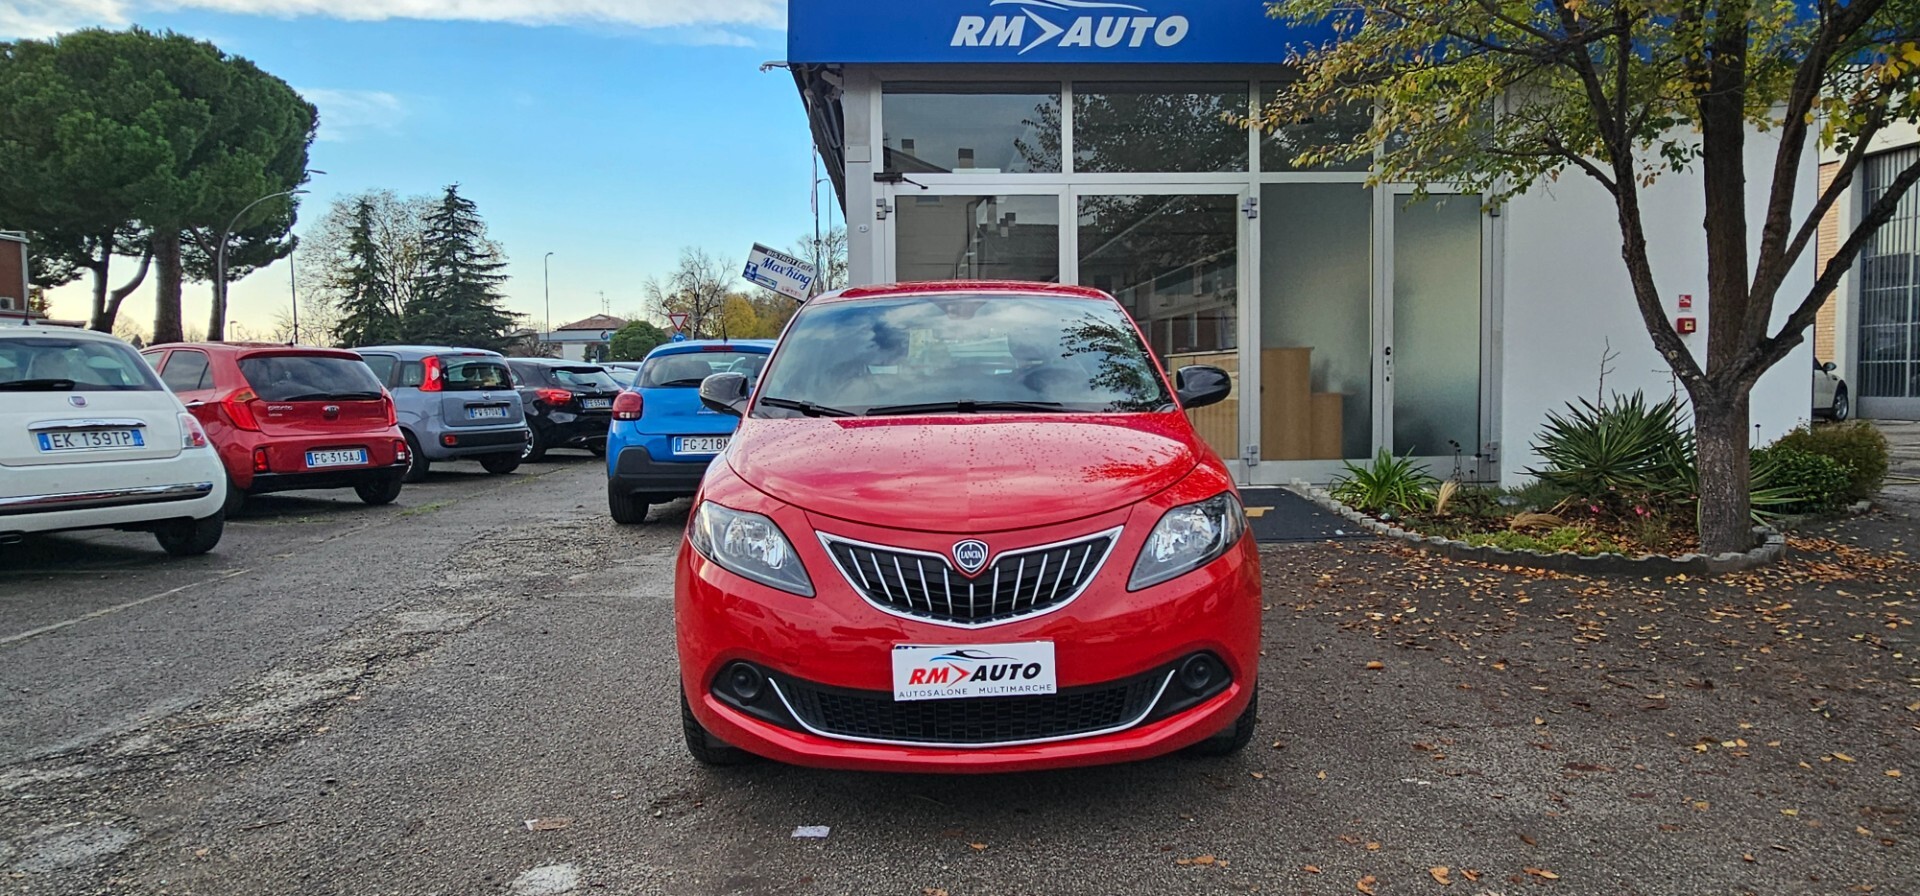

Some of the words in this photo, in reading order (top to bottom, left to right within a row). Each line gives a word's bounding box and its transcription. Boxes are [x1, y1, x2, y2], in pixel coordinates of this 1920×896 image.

[1057, 15, 1190, 48] AUTO
[51, 432, 75, 448] EK
[81, 431, 131, 446] 139TP
[682, 438, 697, 451] FG
[314, 452, 327, 464] FG
[330, 451, 360, 463] 315AJ
[960, 551, 982, 559] LANCIA
[969, 662, 1042, 682] AUTO
[898, 687, 968, 699] AUTOSALONE
[978, 683, 1053, 694] MULTIMARCHE
